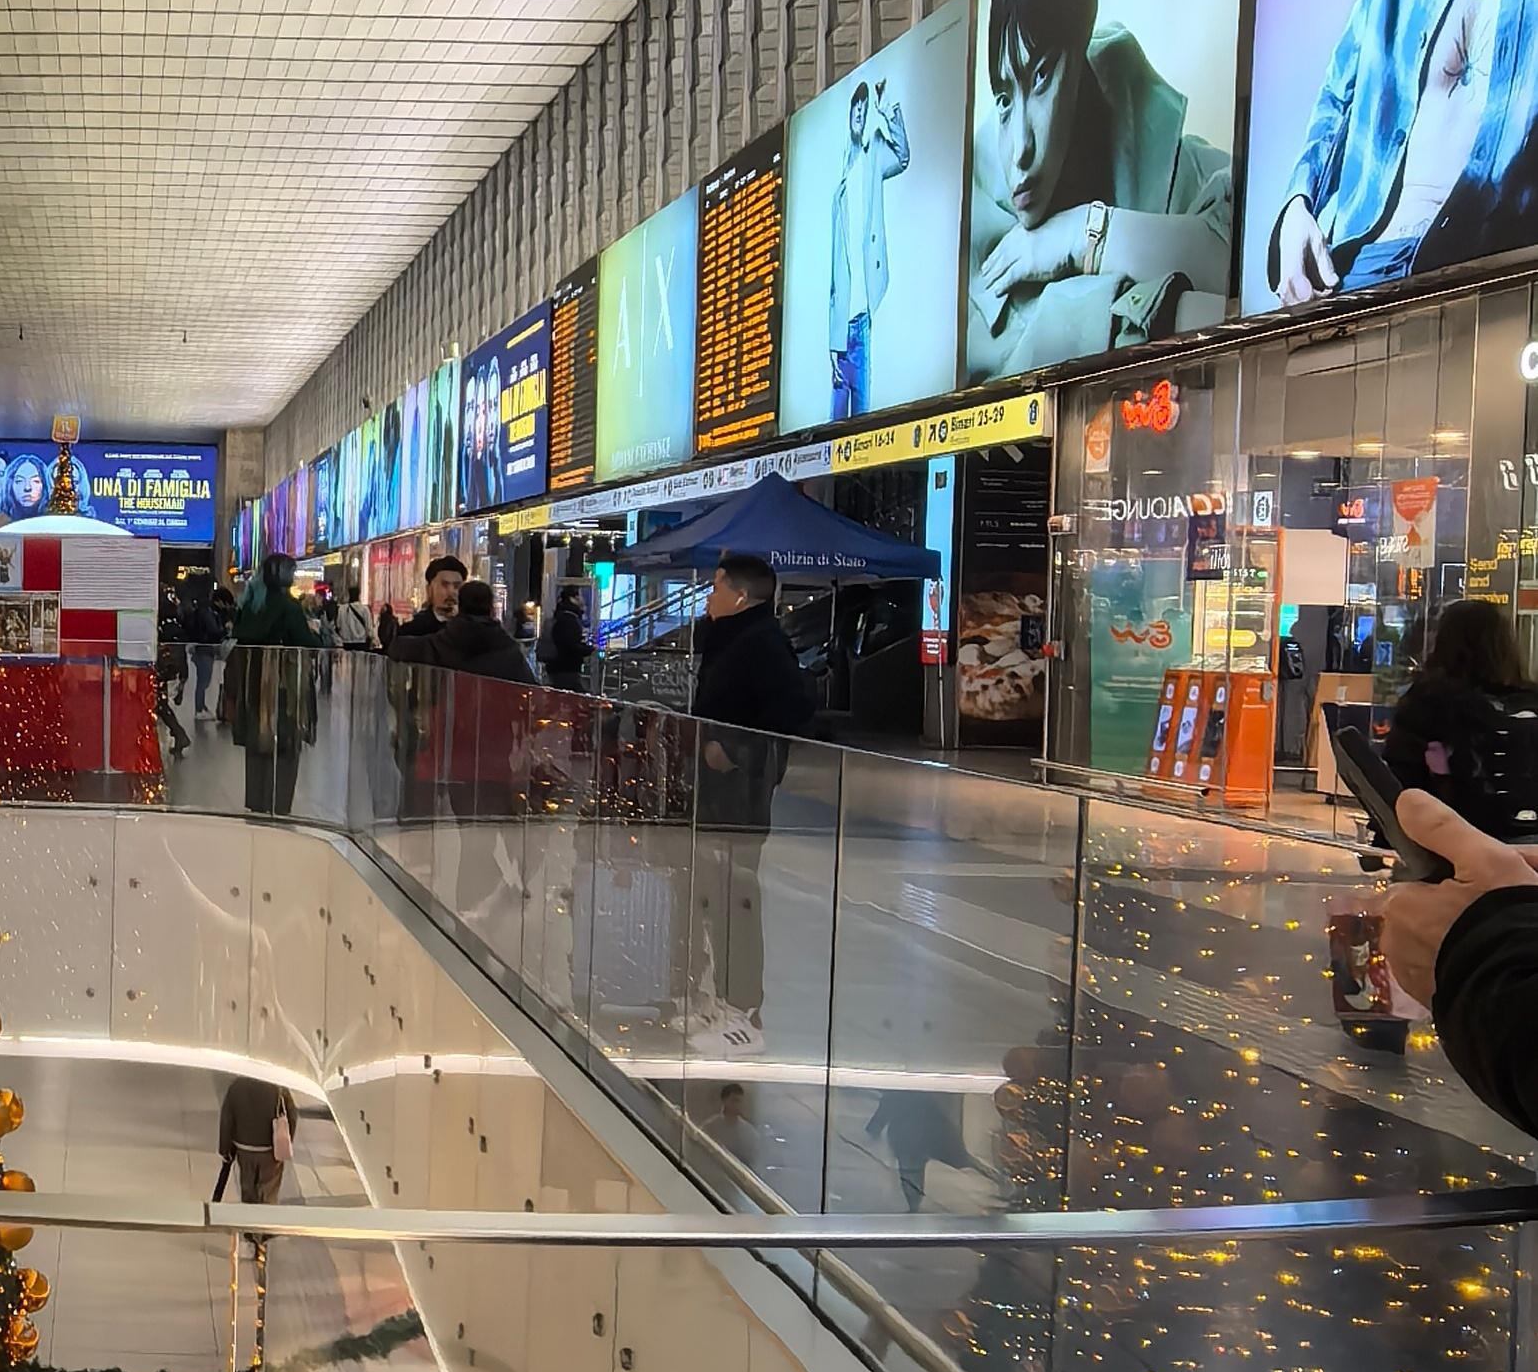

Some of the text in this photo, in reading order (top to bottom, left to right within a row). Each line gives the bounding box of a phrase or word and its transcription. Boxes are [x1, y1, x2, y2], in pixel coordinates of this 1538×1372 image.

[94, 477, 211, 499] UNA DI FAMIGLIA
[119, 497, 136, 509] THE
[770, 550, 867, 567] Polizia di Stato
